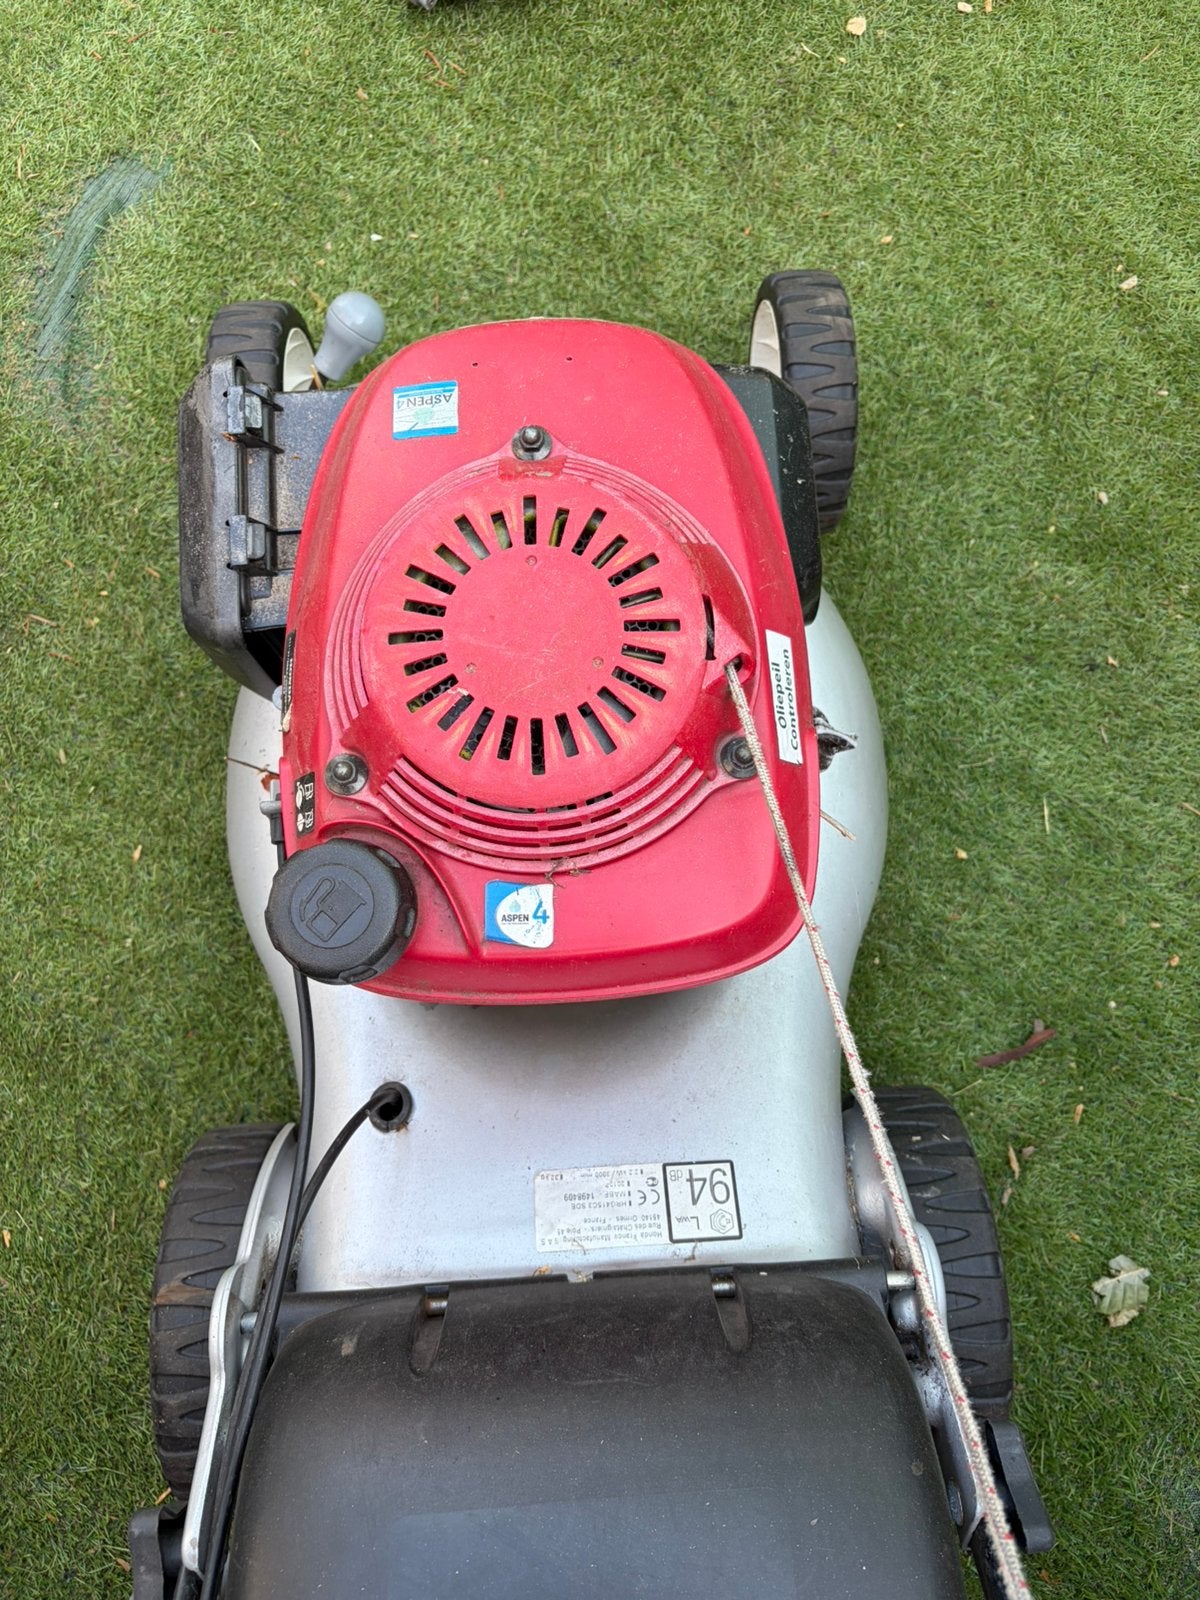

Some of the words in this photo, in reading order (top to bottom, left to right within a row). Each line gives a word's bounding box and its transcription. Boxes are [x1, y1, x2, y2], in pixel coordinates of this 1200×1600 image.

[407, 393, 453, 407] ASPEN
[771, 662, 787, 729] Oliepeil
[782, 649, 798, 750] Controleren
[501, 913, 529, 922] ASPEN
[532, 899, 550, 924] 4
[669, 1169, 683, 1182] dB
[685, 1168, 730, 1205] 94
